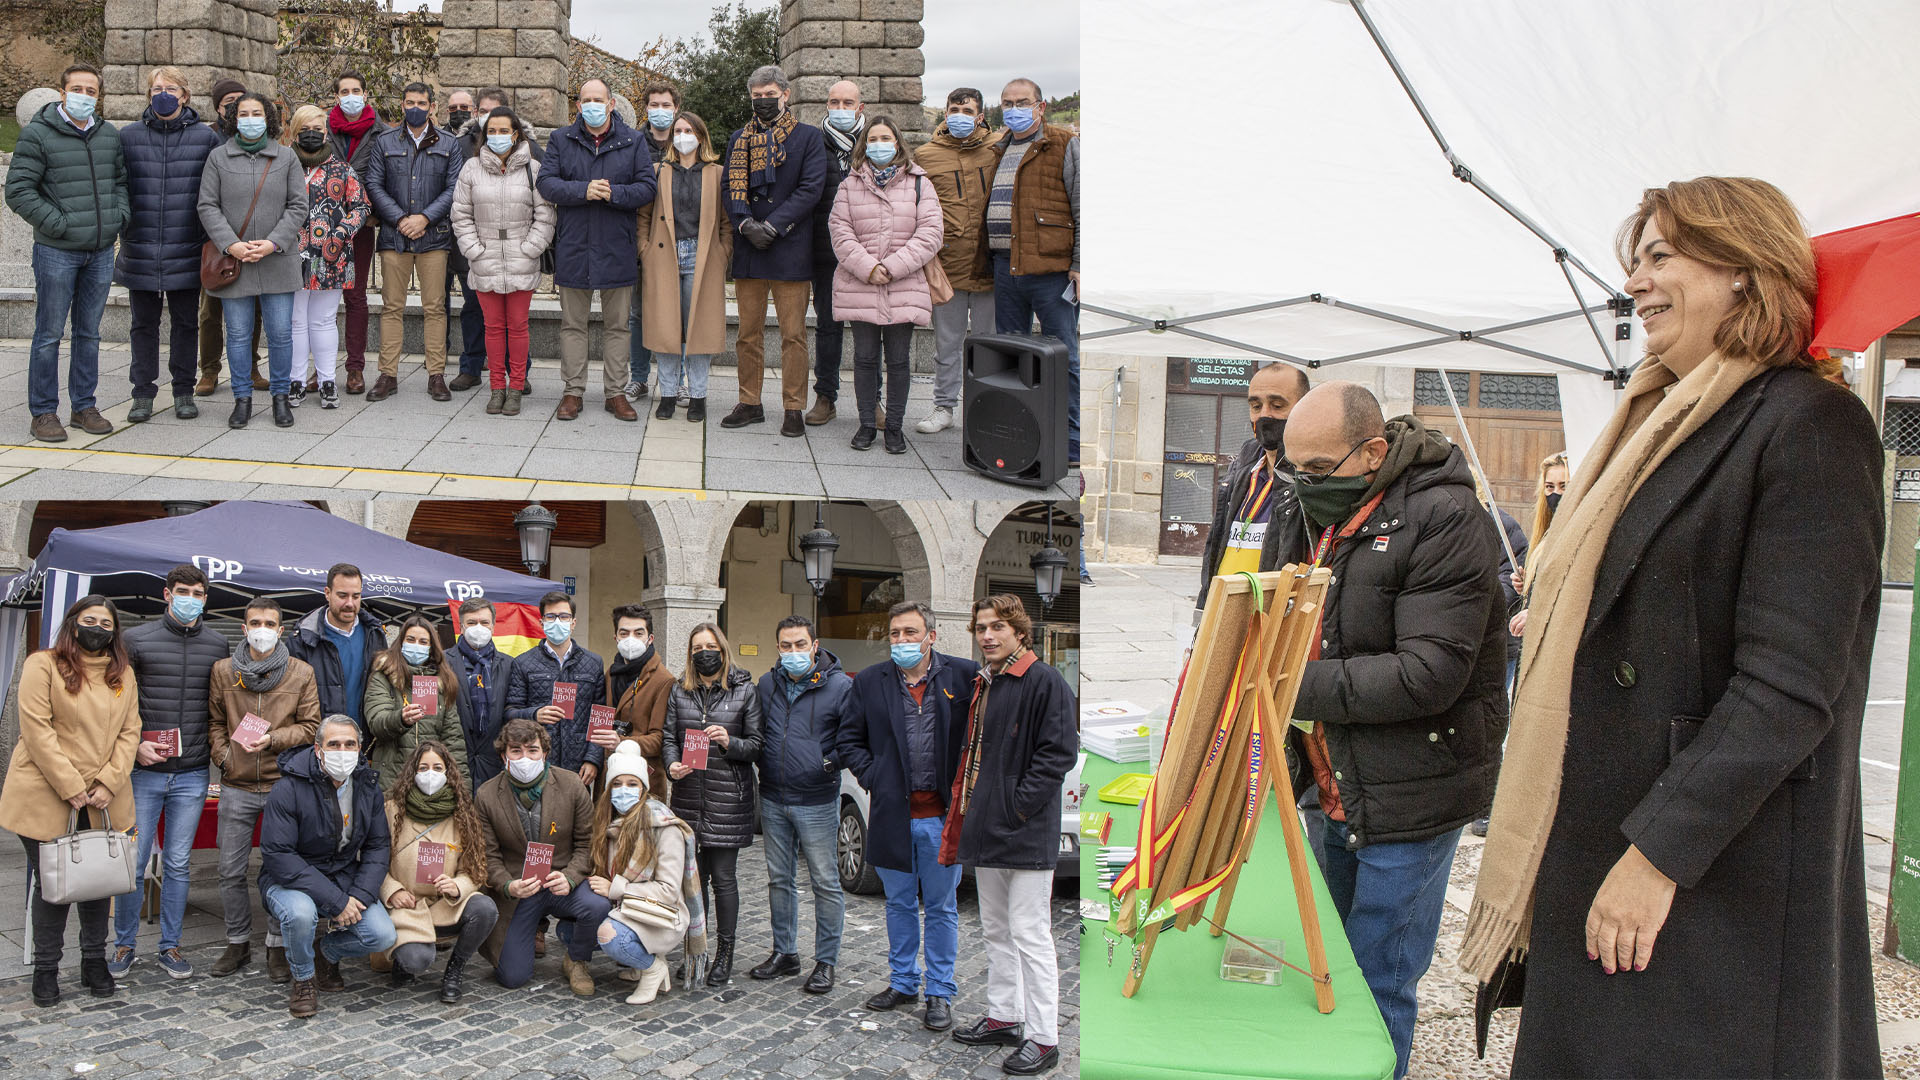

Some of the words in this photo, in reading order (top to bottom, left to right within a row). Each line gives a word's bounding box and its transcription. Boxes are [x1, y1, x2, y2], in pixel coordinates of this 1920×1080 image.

[1197, 365, 1245, 376] SELECTAS
[1190, 377, 1220, 385] VARIEDAD
[366, 582, 413, 597] Segovia
[1245, 732, 1262, 774] ESPAÑA
[417, 845, 445, 855] tución
[417, 853, 444, 864] añola
